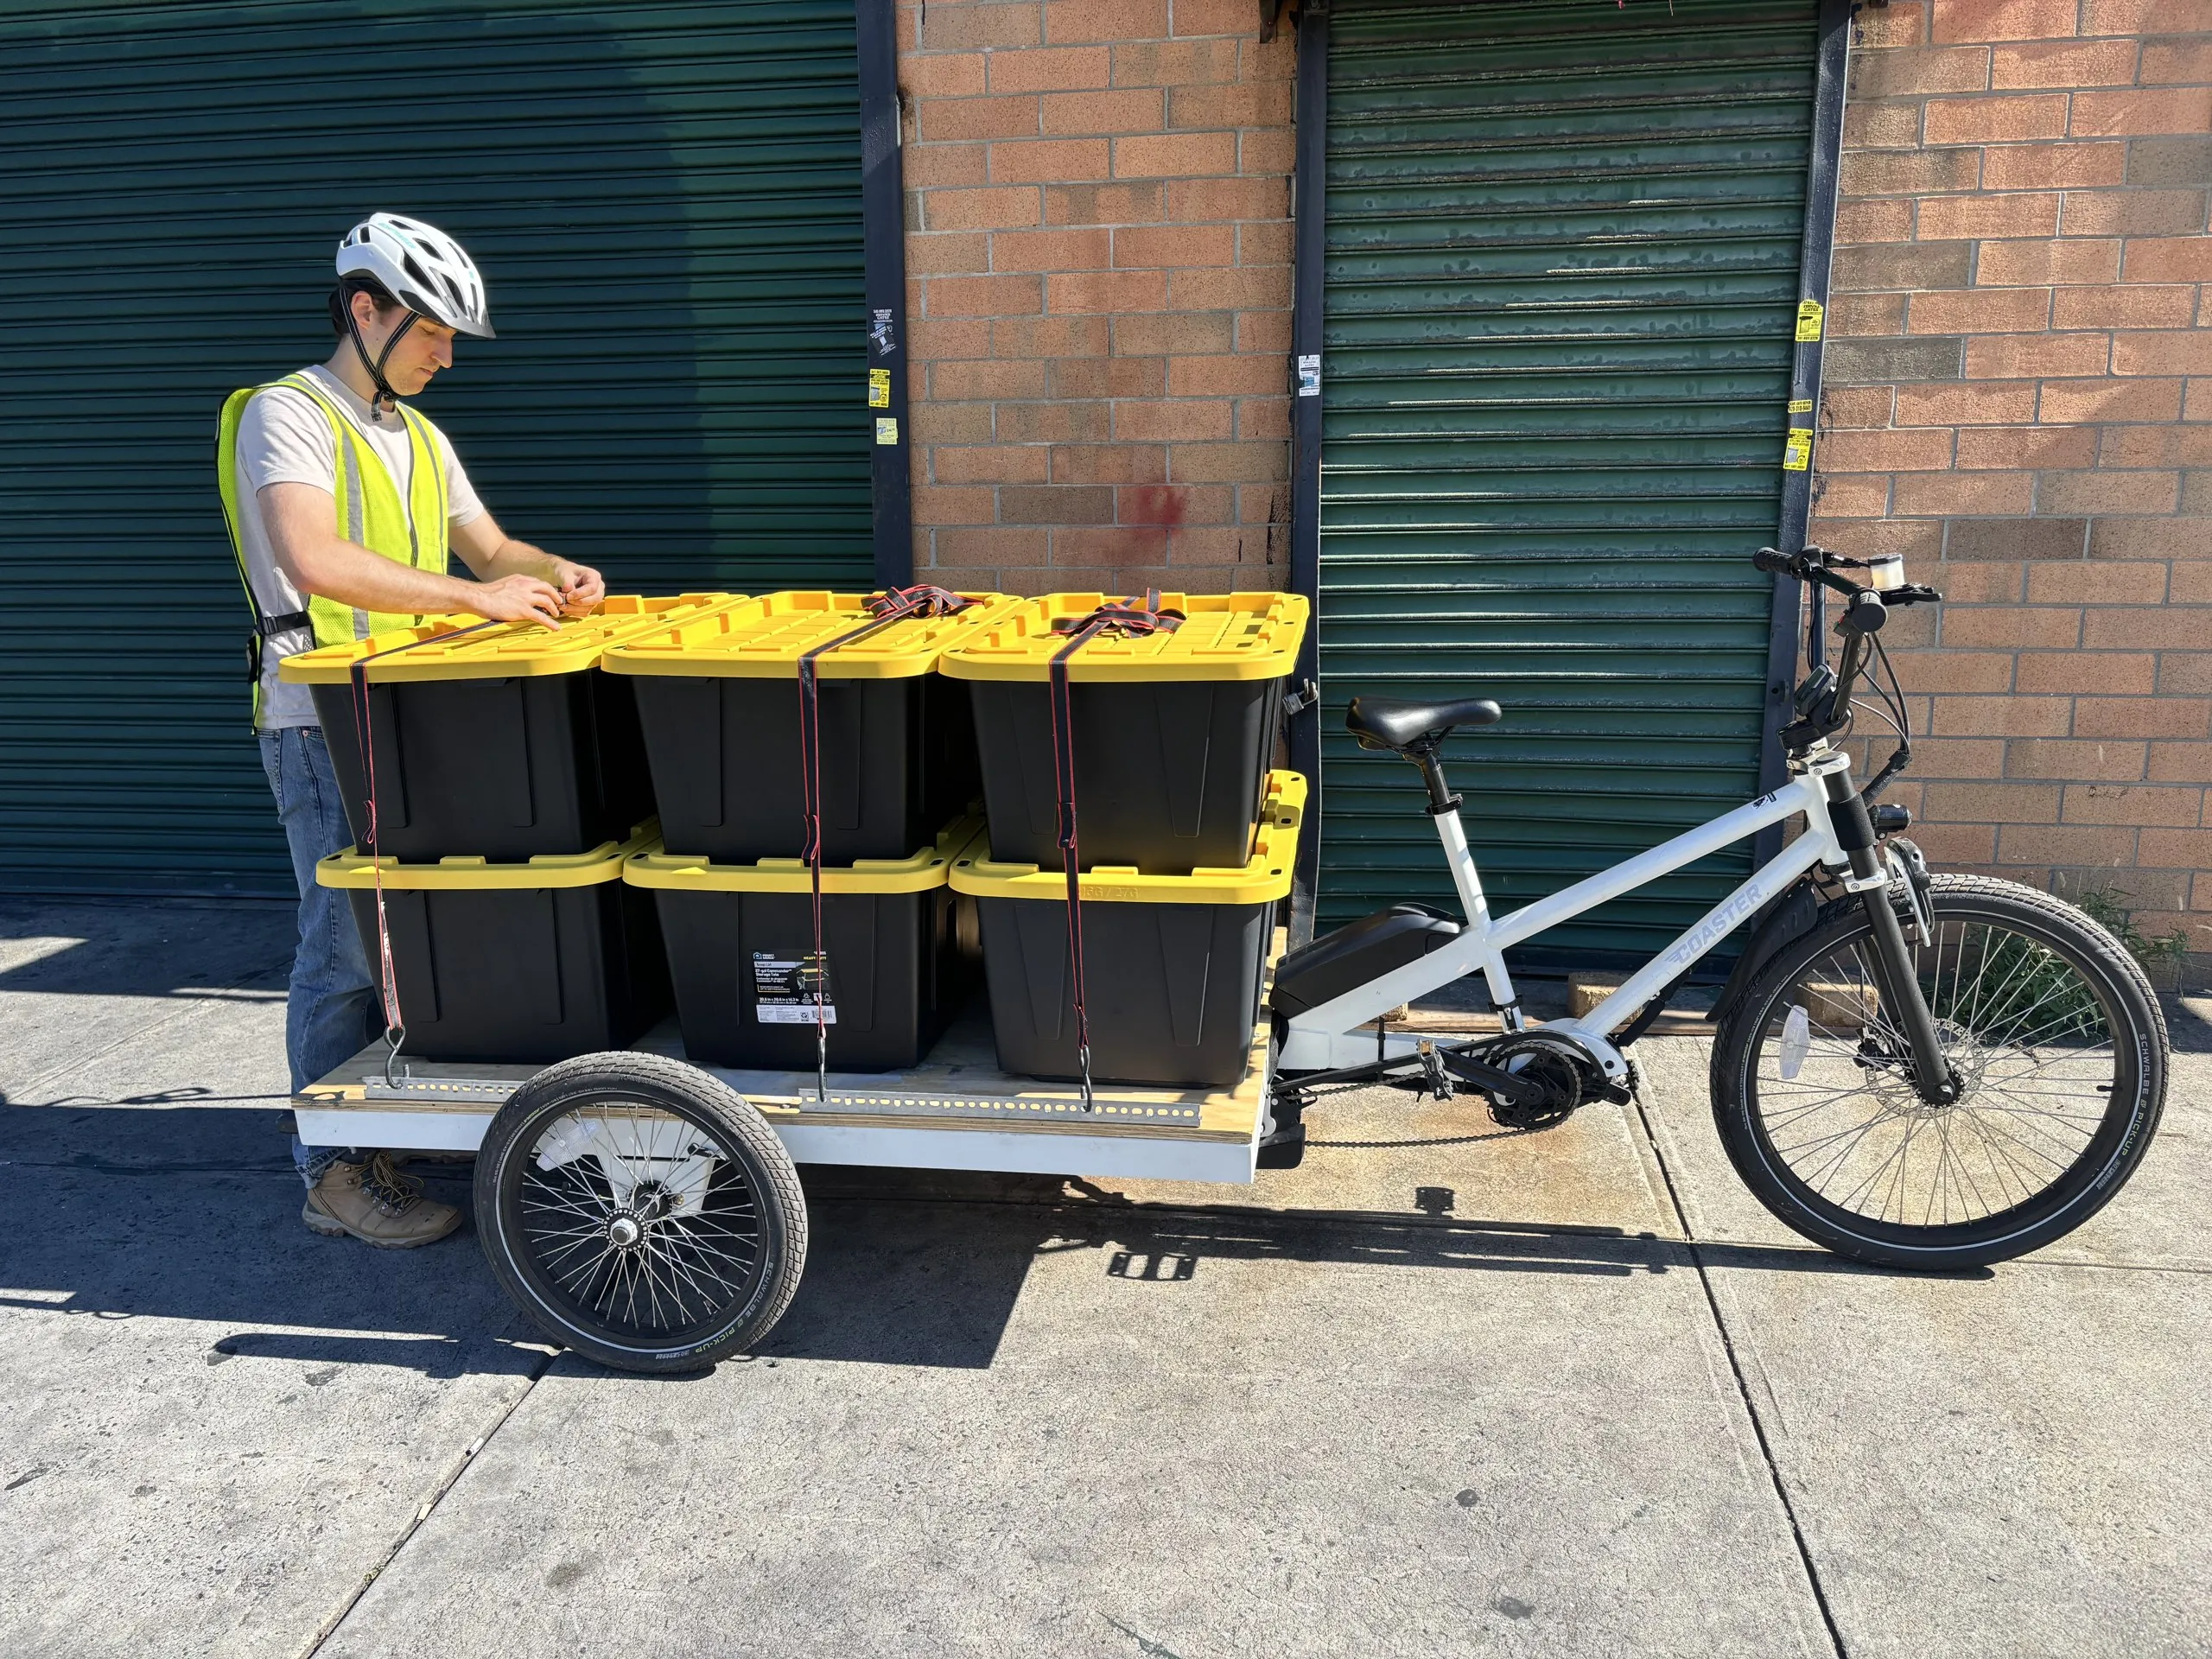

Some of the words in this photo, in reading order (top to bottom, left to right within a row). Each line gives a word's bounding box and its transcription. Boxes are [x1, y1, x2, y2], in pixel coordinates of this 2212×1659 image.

[1667, 883, 1763, 964] COASTER
[2139, 1033, 2151, 1096] SCHWALBE
[2121, 1112, 2145, 1156] PICK-UP
[746, 1262, 774, 1319] SCHWALBE
[695, 1328, 736, 1353] PICK-UP
